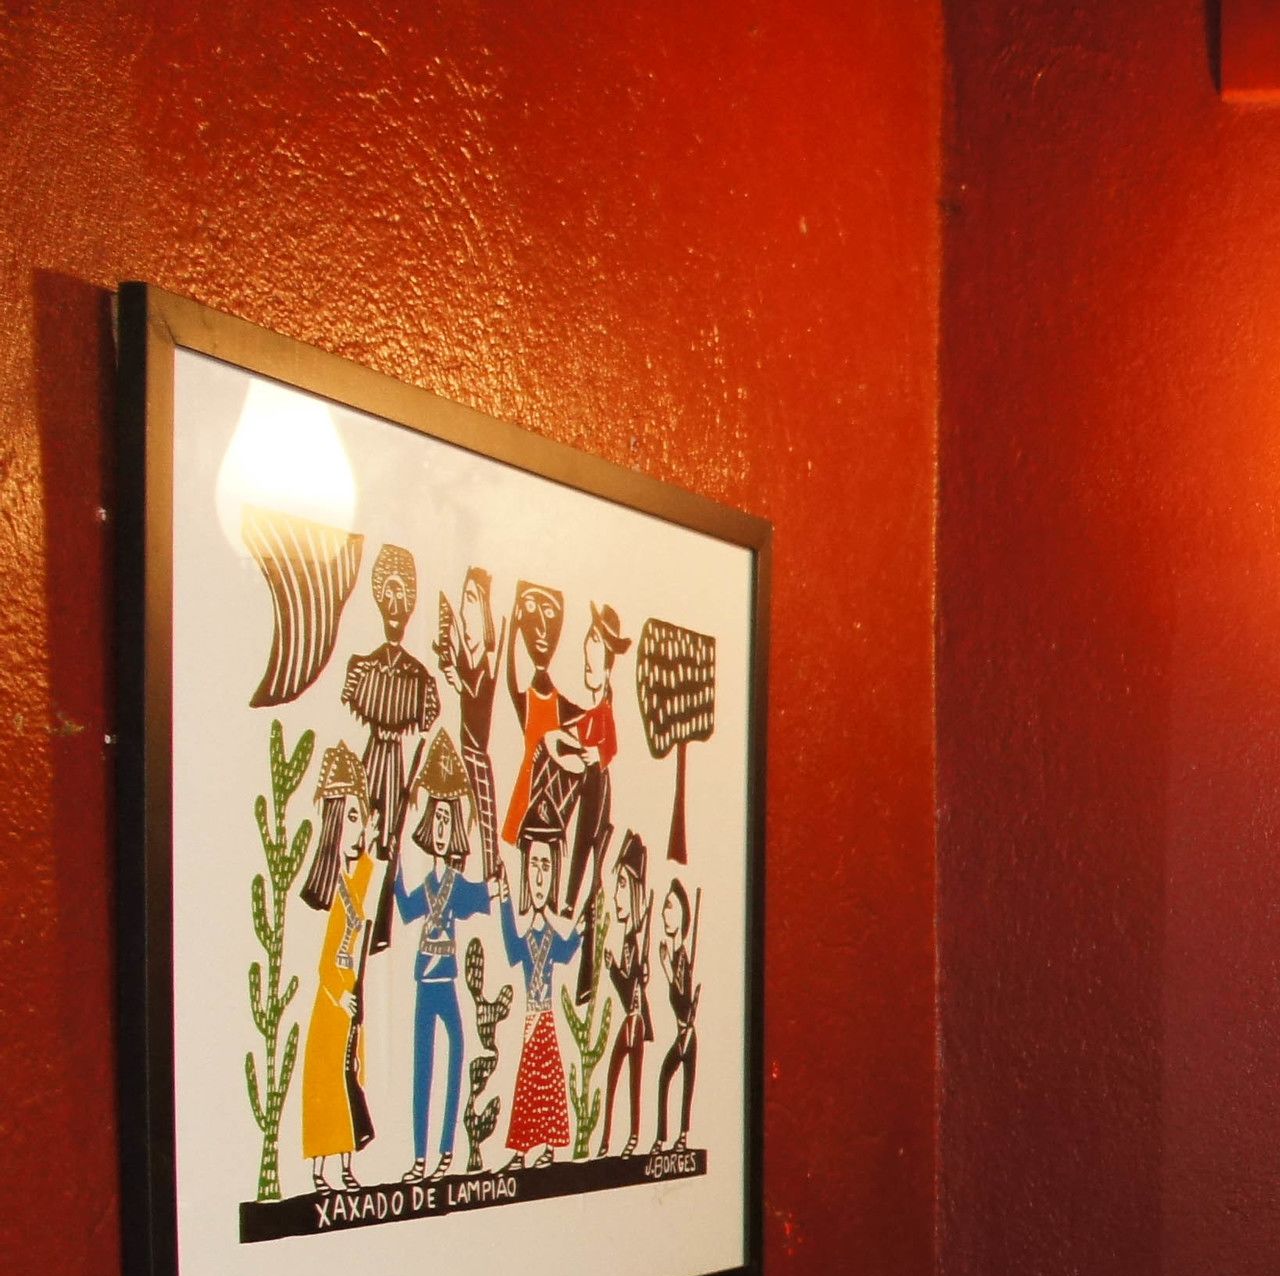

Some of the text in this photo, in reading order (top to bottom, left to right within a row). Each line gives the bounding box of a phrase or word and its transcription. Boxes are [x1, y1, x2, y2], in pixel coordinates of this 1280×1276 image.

[315, 1173, 517, 1229] XAXADO DE LAMPIÃO
